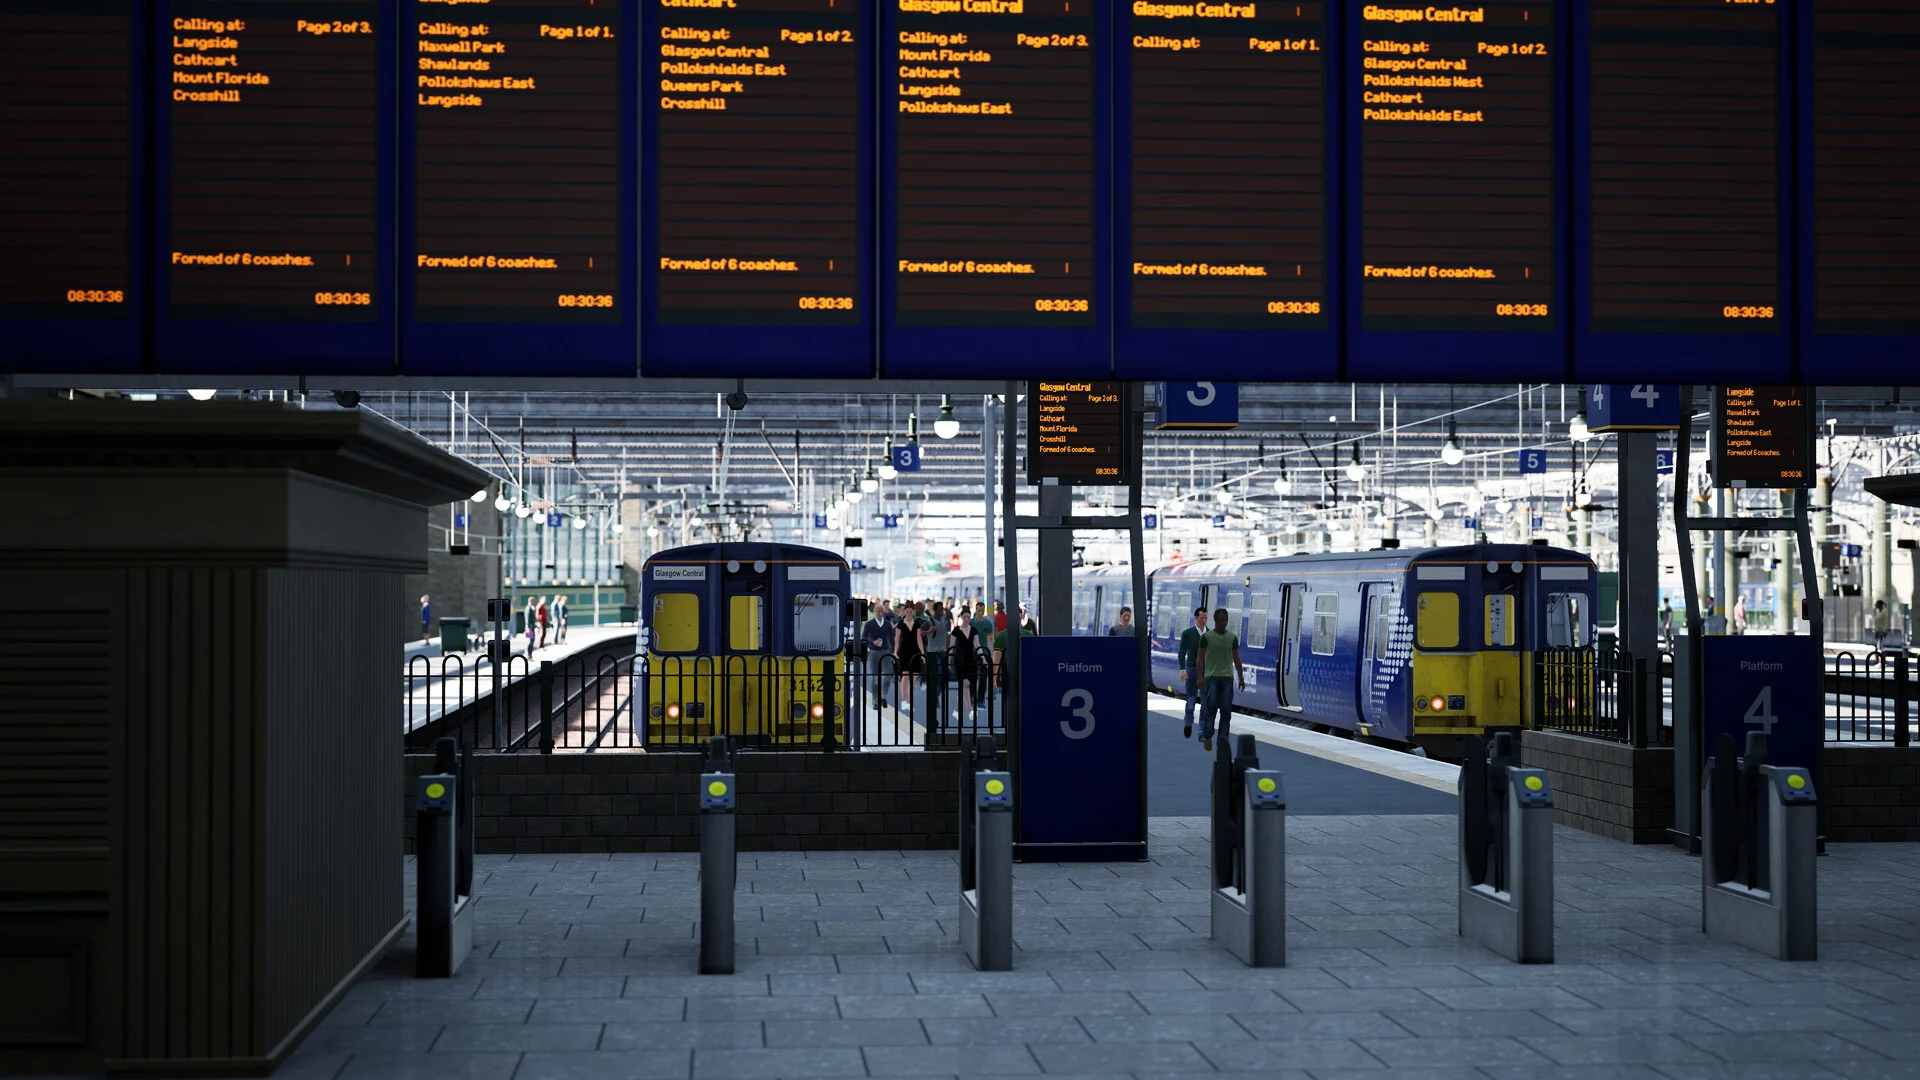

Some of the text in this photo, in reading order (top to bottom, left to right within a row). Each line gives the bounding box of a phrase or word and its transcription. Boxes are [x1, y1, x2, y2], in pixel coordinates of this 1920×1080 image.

[899, 0, 1023, 14] Glasgow Central
[1133, 1, 1255, 18] Glasgow Central
[1363, 6, 1484, 23] Glasgow Central
[174, 18, 244, 33] Calling at:
[298, 20, 372, 35] Page 2 of 3.
[419, 23, 488, 37] Calling at:
[540, 25, 614, 39] Page 1 of 1.
[661, 27, 730, 42] Calling at:
[781, 29, 853, 44] Page 1 of 2.
[900, 32, 967, 46] Calling at:
[1017, 34, 1088, 48] Page 2 of 3.
[174, 36, 238, 50] Langside
[419, 40, 505, 53] Maxwell Park
[1133, 36, 1200, 50] Calling at:
[1250, 38, 1320, 52] Page 1 of 1.
[1364, 40, 1429, 54] Calling at:
[1478, 42, 1547, 56] Page 1 of 2.
[661, 44, 769, 59] Glasgow Central
[899, 49, 991, 62] Mount Florida
[174, 54, 237, 66] Cathcart
[419, 58, 490, 70] Shawlands
[1364, 57, 1467, 71] Glasgow Central
[661, 62, 786, 76] Pollokshields East
[899, 66, 960, 79] Cathcart
[174, 72, 269, 84] Mount Florida
[419, 75, 535, 89] Pollokshaws East
[1364, 74, 1483, 88] Pollokshields West
[661, 80, 743, 92] Queens Park
[899, 84, 961, 98] Langside
[173, 89, 240, 102] Crosshill
[419, 94, 482, 108] Langside
[1364, 91, 1423, 103] Cathcart
[661, 97, 726, 110] Crosshill
[900, 101, 1012, 114] Pollokshaws East
[1364, 109, 1483, 122] Pollokshields East
[172, 252, 314, 265] Formed of 6 coaches.
[418, 255, 558, 268] Formed of 6 coaches.
[661, 258, 798, 271] Formed of 6 coaches.
[899, 260, 1034, 273] Formed of 6 coaches.
[1134, 263, 1267, 276] Formed of 6 coaches.
[1364, 265, 1495, 278] Formed of 6 coaches.
[68, 290, 123, 302] 08:30:36
[315, 292, 370, 305] 08:30:36
[558, 295, 613, 307] 08:30:36
[799, 297, 853, 309] 08:30:36
[1035, 300, 1088, 311] 08:30:36
[1268, 302, 1320, 313] 08:30:36
[1496, 304, 1547, 316] 08:30:36
[1724, 306, 1773, 318] 08:30:36
[1040, 383, 1091, 392] Glasgow Central
[1187, 381, 1216, 406] 3
[1727, 388, 1754, 397] Langside
[1088, 395, 1101, 403] Page
[1593, 384, 1603, 410] 4
[1630, 384, 1660, 408] 4
[1727, 399, 1746, 407] Calling
[900, 450, 912, 466] 3
[1528, 454, 1538, 468] 5
[551, 516, 558, 525] 2
[655, 569, 704, 578] Glasgow Central
[1058, 662, 1102, 673] Platform
[1740, 661, 1783, 670] Platform
[790, 679, 842, 692] 31420
[1060, 688, 1096, 740] 3
[1744, 686, 1778, 734] 4
